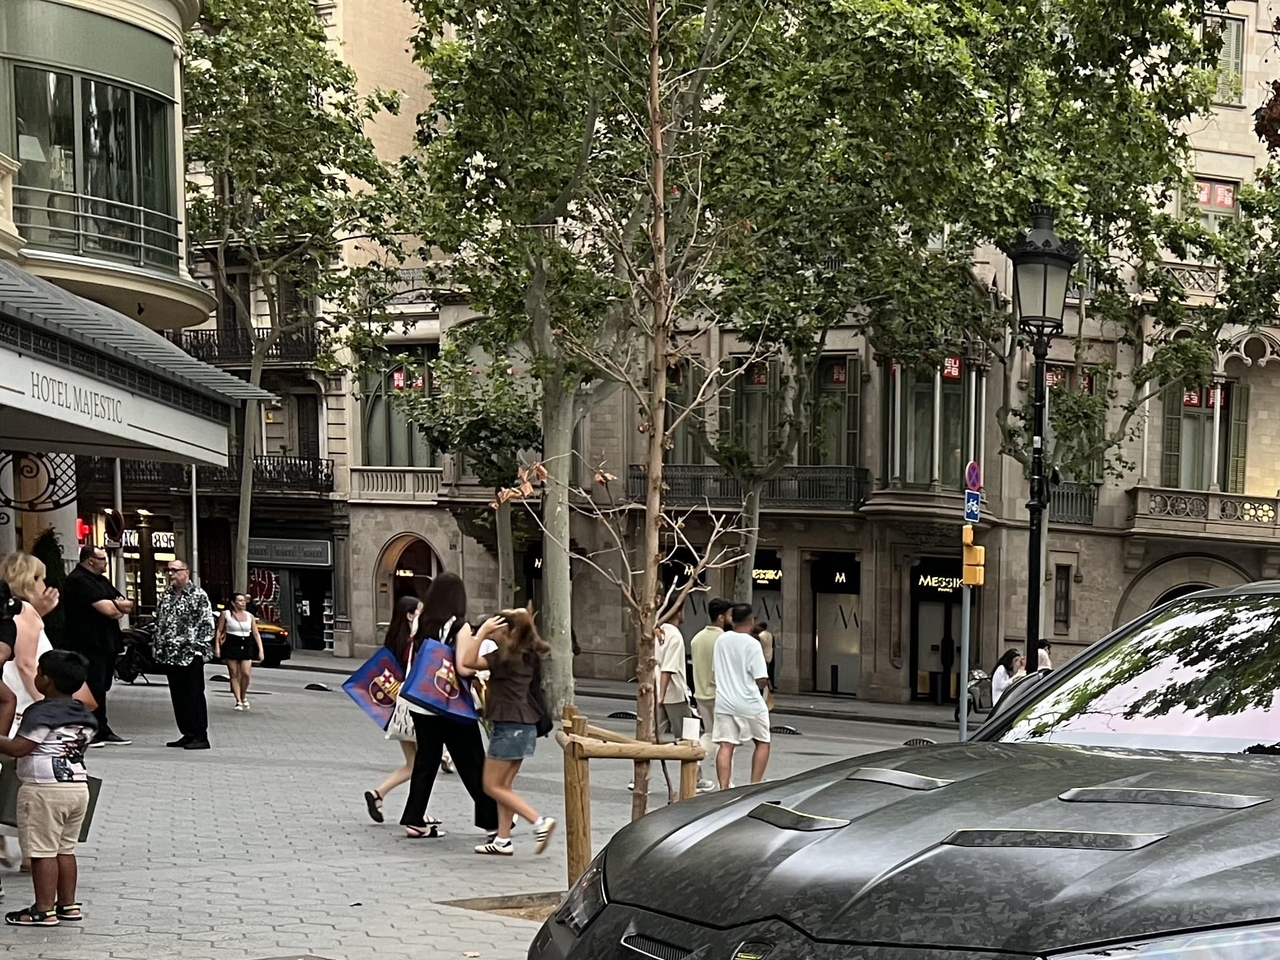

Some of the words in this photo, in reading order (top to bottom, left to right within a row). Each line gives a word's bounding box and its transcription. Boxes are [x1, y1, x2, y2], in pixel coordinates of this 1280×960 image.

[30, 371, 72, 410] HOTEL
[72, 385, 123, 424] MAJESTIC
[751, 569, 783, 580] ESSIKA
[834, 572, 847, 583] M
[918, 574, 973, 588] MESSIK
